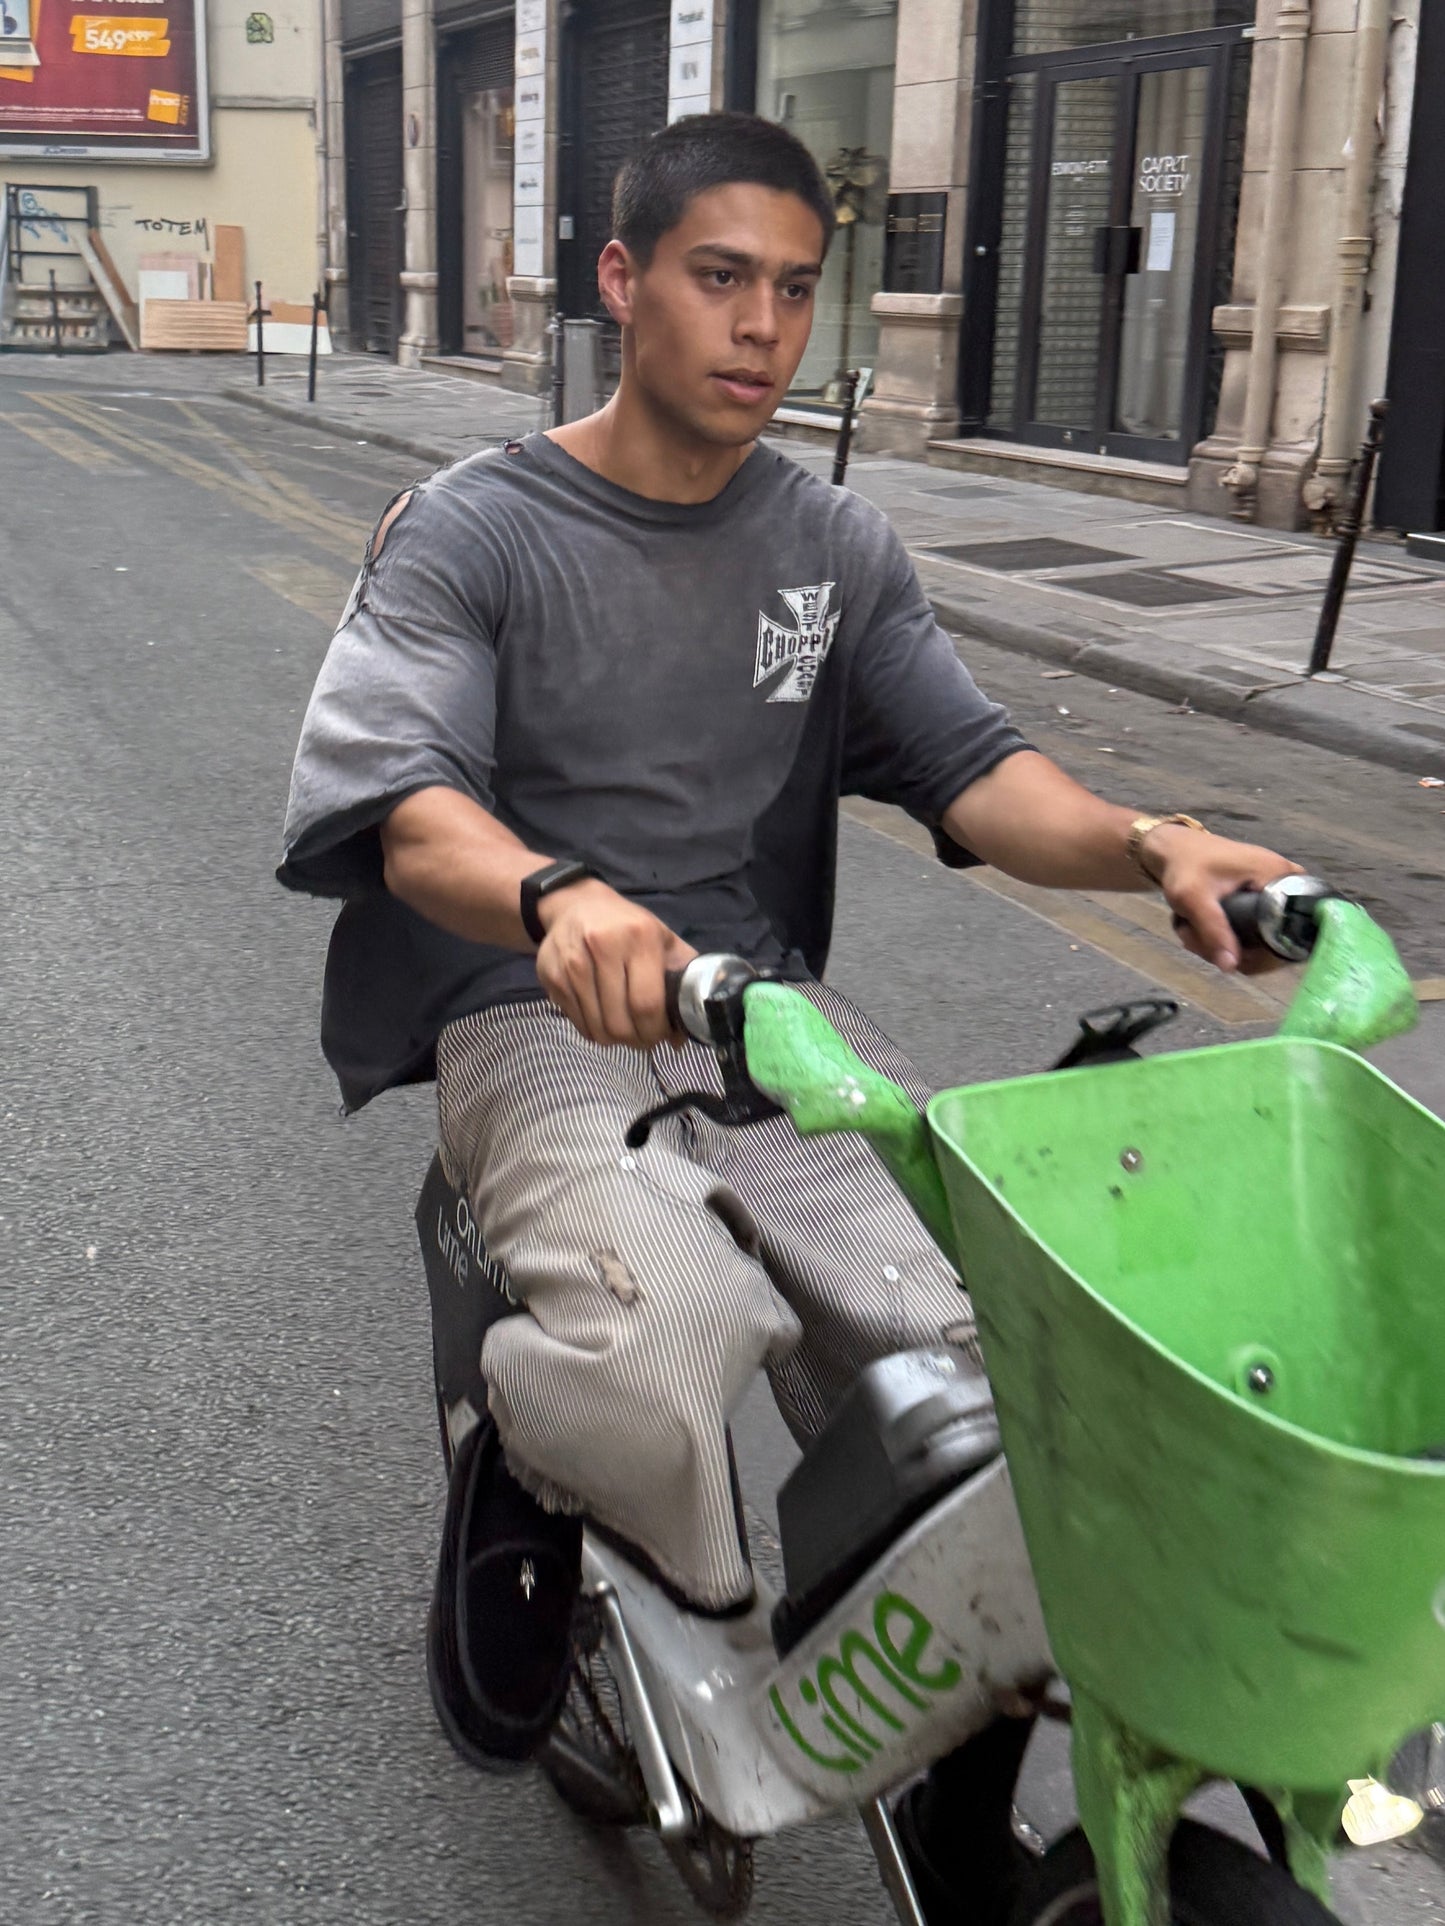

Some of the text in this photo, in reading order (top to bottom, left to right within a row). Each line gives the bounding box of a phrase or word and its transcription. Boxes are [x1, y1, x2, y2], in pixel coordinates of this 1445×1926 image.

[134, 217, 210, 251] TOTEM
[800, 591, 819, 631] WEST
[456, 1197, 476, 1256] On
